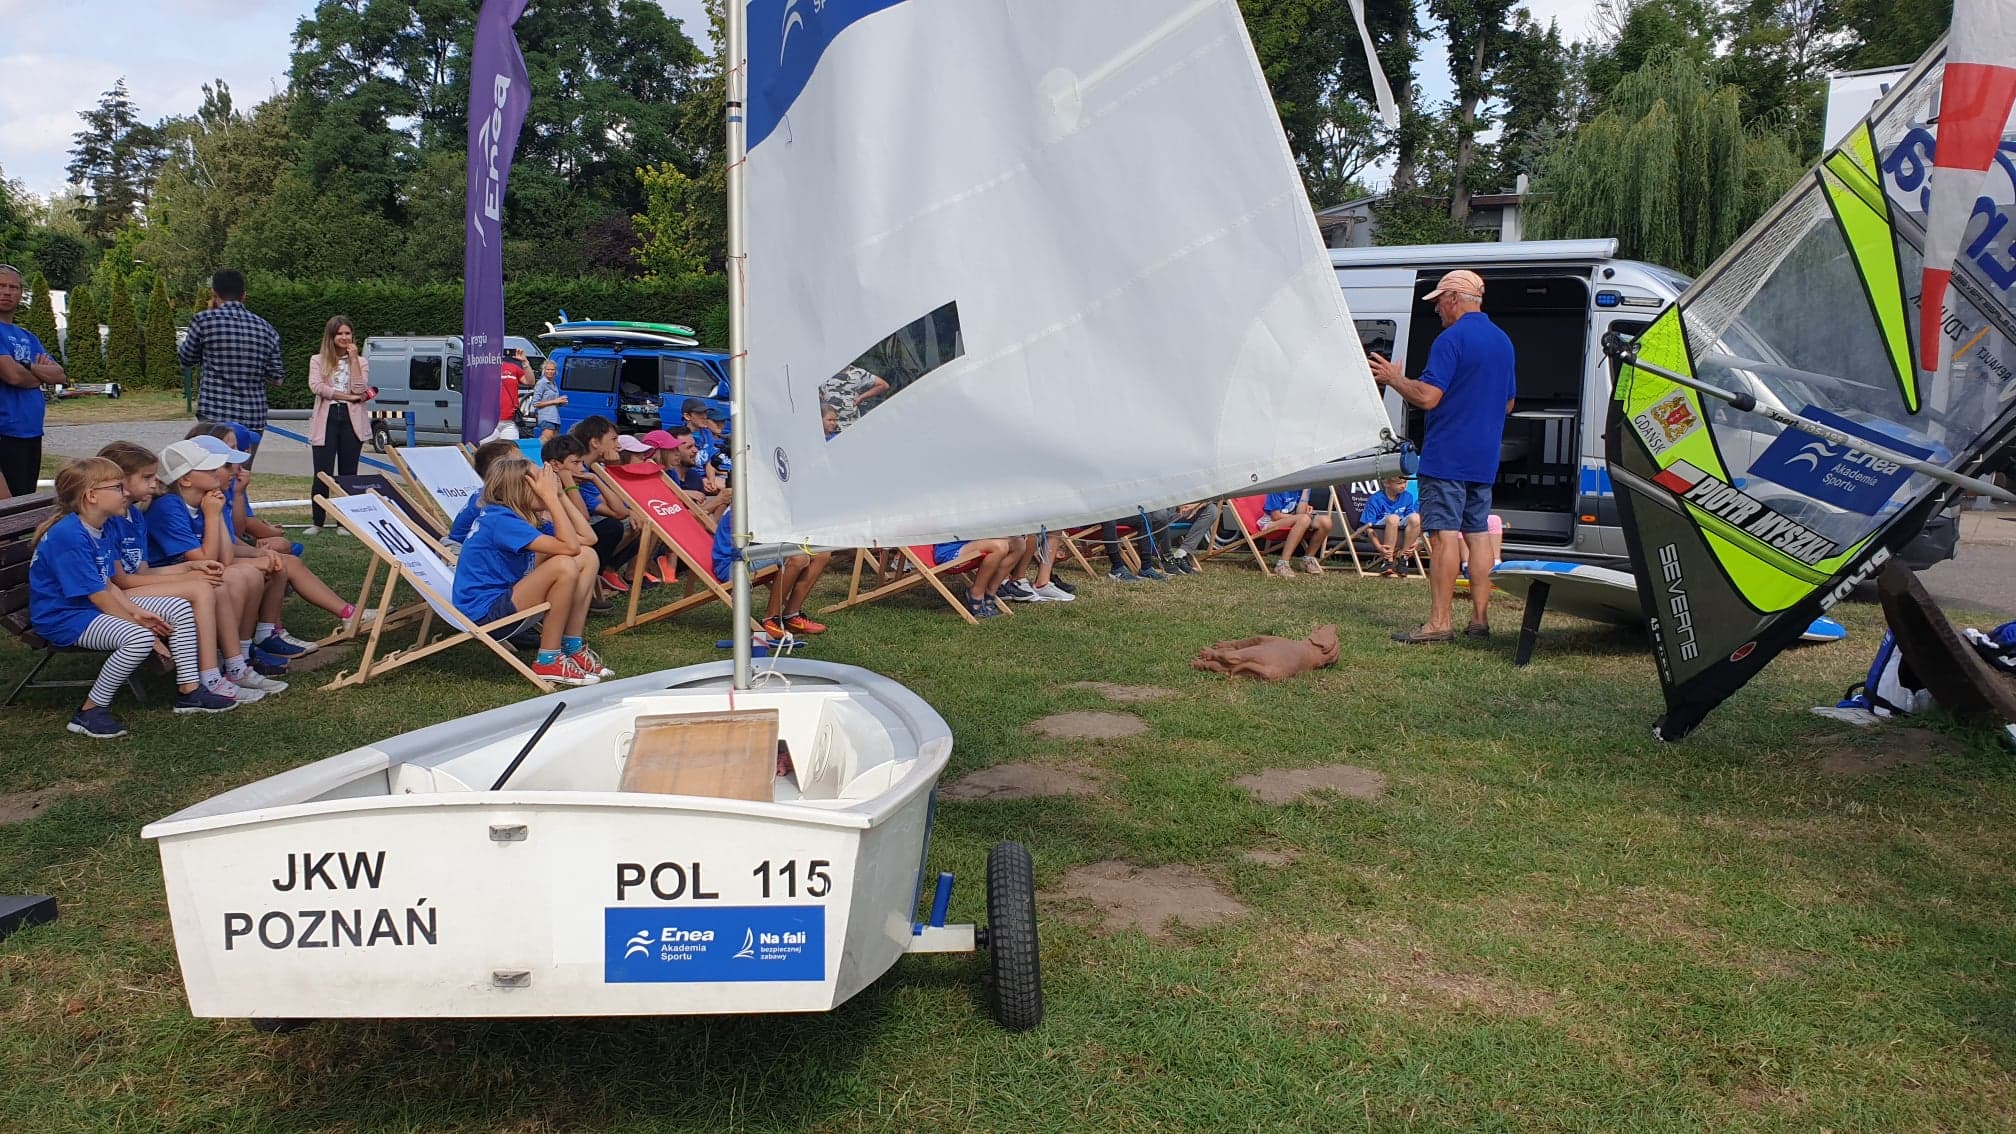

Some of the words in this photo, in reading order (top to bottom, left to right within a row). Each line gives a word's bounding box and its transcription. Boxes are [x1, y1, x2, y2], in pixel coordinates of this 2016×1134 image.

[485, 73, 511, 221] Enea
[1634, 414, 1666, 455] GDAŃSK
[1822, 473, 1856, 493] Sportu
[1831, 463, 1879, 487] Akademia
[653, 502, 683, 517] Enea
[1686, 477, 1762, 525] PIOTR
[1745, 512, 1836, 565] MYSZKA
[1658, 542, 1700, 661] SEVERNE
[272, 851, 386, 892] JKW
[616, 862, 719, 901] POL
[753, 860, 832, 898] 115
[224, 898, 438, 950] POZNAŃ
[661, 927, 715, 942] Enea
[661, 943, 707, 952] Akademia
[760, 932, 779, 944] Na
[783, 931, 806, 944] fali
[661, 952, 692, 962] Sportu
[760, 953, 787, 961] zabawy
[761, 946, 802, 955] bezpiecznej
